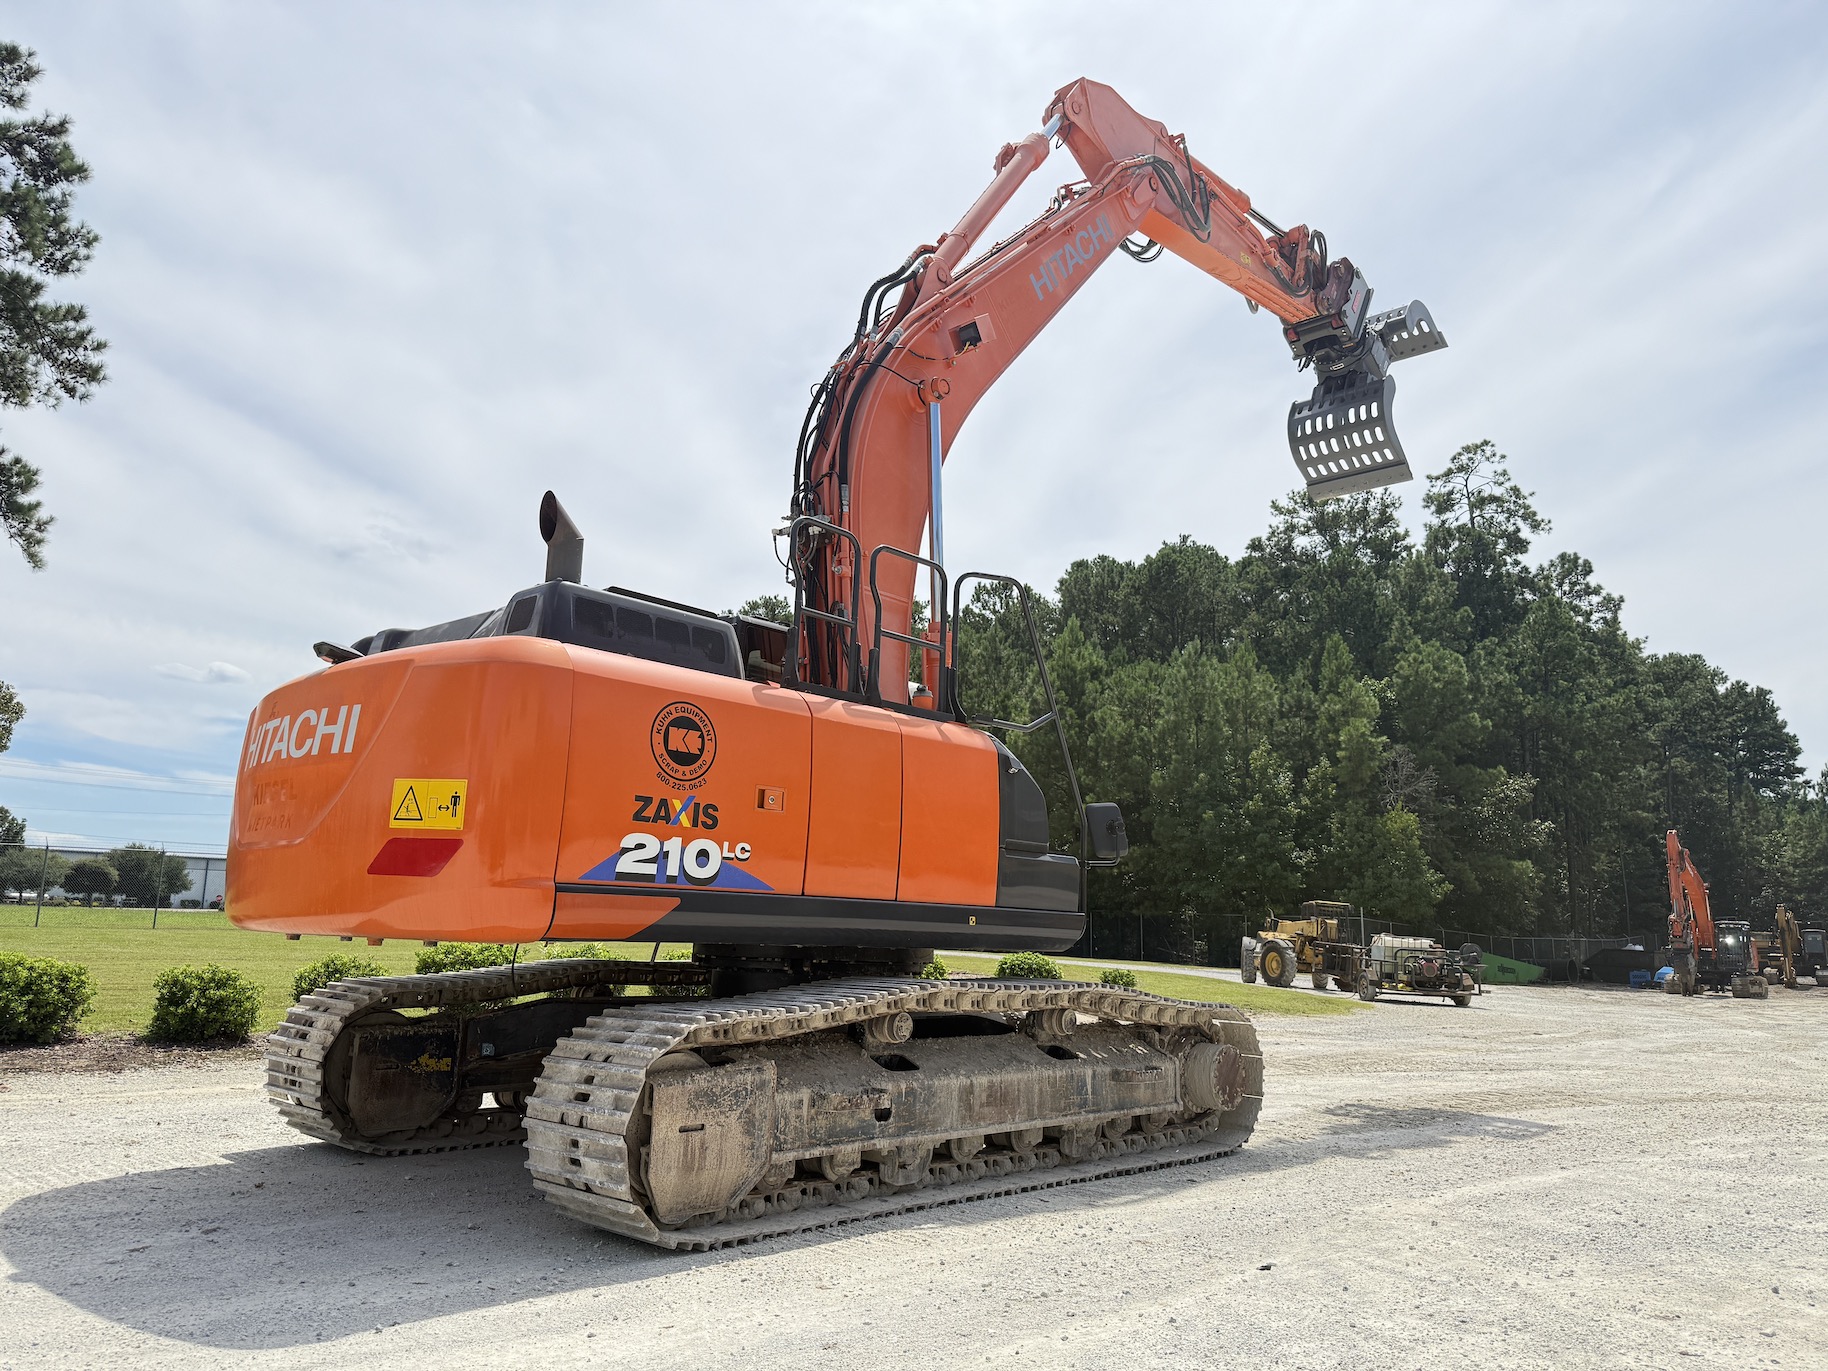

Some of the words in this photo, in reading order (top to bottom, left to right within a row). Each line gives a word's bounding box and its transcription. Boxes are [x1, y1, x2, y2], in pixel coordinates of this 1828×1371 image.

[1029, 213, 1114, 301] HITACHI
[244, 704, 362, 772] HITACHI
[656, 709, 673, 735] KUHN
[674, 706, 713, 743] EQUIPMENT
[655, 771, 708, 791] 800.225.0623
[658, 753, 680, 775] SCRAP
[689, 759, 708, 776] DEMO
[632, 795, 719, 830] ZAXIS
